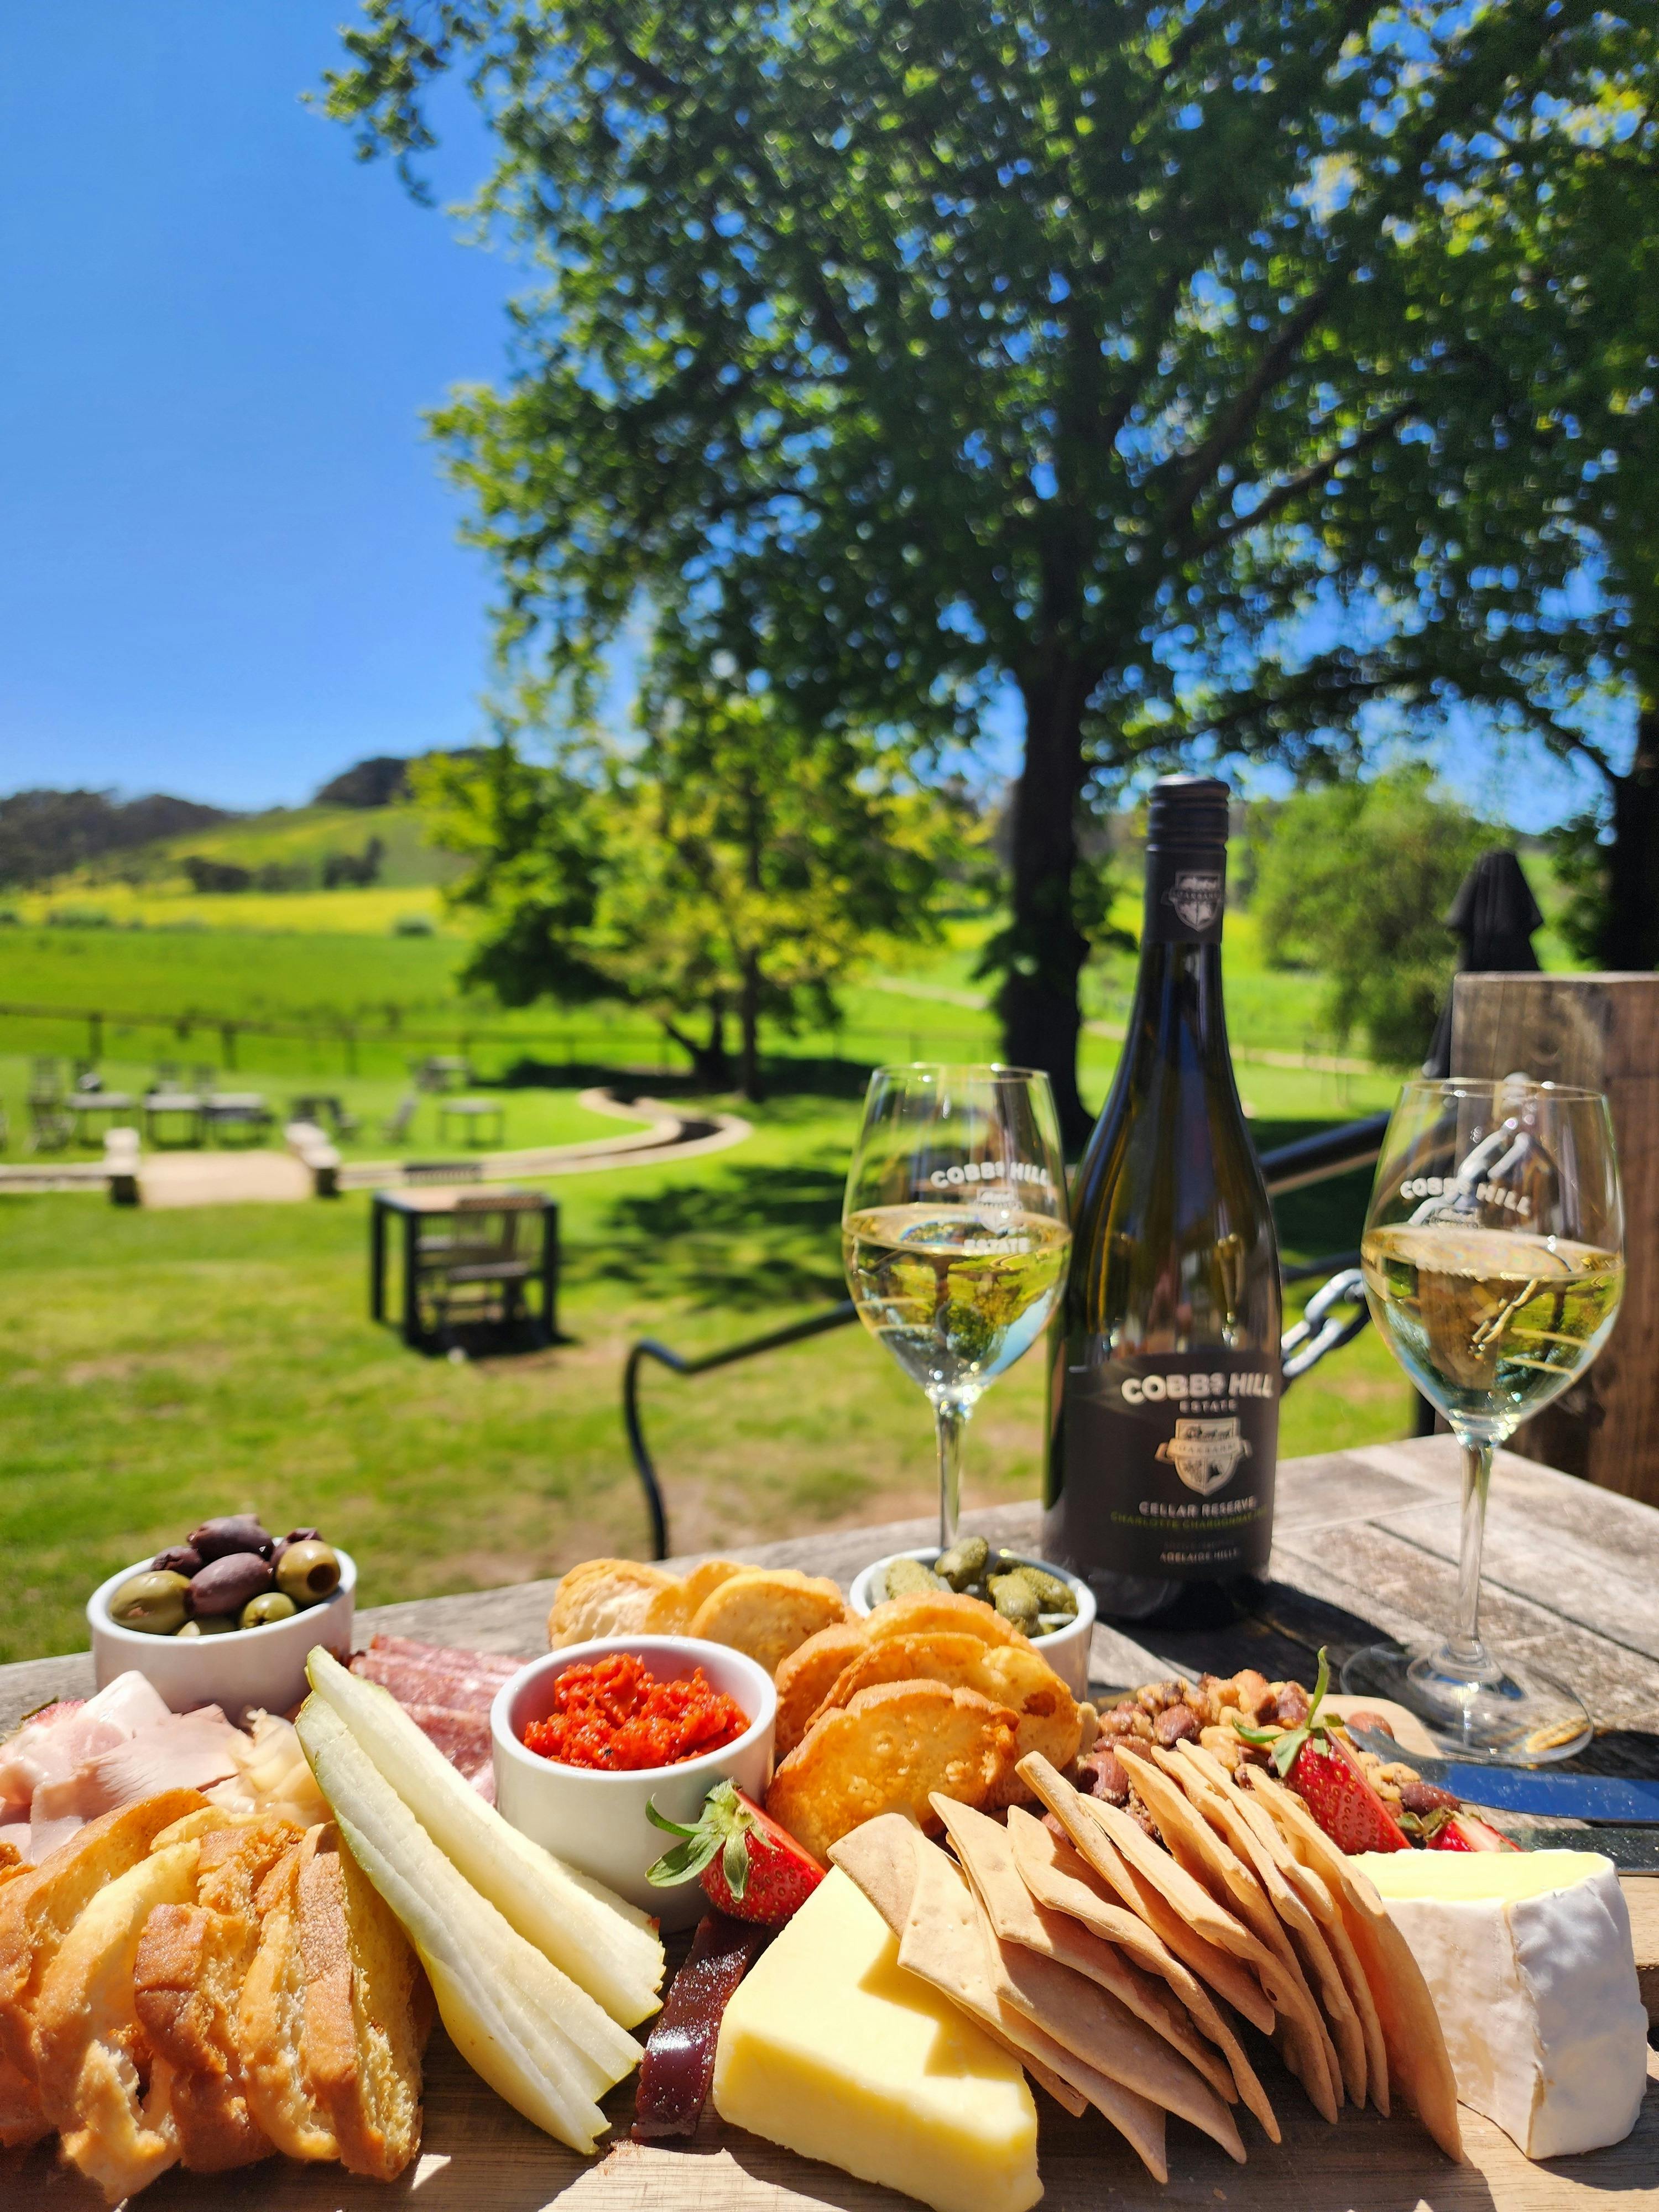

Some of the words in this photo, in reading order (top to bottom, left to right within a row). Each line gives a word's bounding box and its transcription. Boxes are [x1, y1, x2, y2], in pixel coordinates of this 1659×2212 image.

[1010, 1162, 1050, 1186] HILL
[1475, 1182, 1531, 1216] HILL
[964, 1238, 1030, 1255] ESTATE
[1228, 1372, 1272, 1399] HILL
[1179, 1399, 1238, 1413] ESTATE
[1139, 1501, 1198, 1518] CELLAR
[1202, 1496, 1257, 1516] RESERVE
[1110, 1511, 1178, 1528] CHARLOTTE
[1160, 1551, 1210, 1563] ADELAIDE
